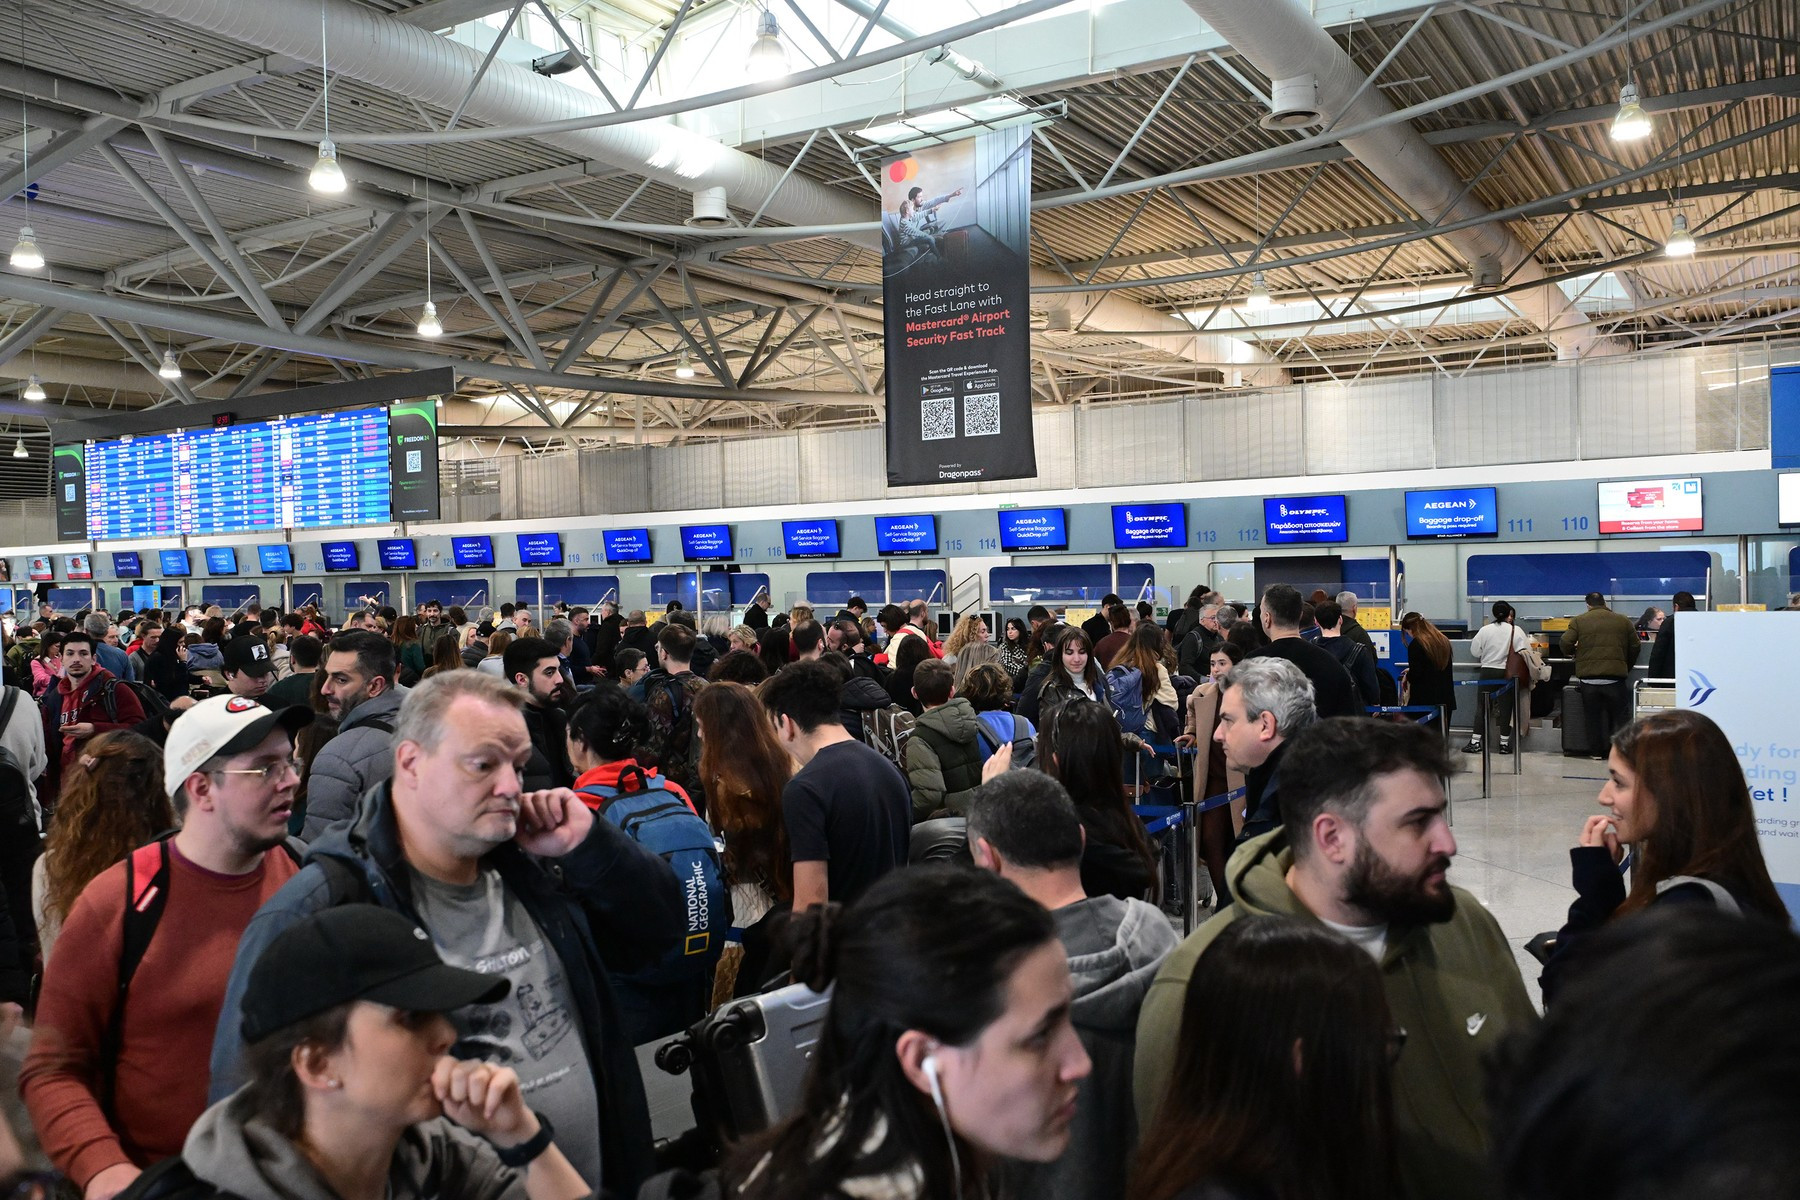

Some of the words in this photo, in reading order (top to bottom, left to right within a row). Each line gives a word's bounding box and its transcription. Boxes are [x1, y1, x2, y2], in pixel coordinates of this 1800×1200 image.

[905, 289, 932, 303] Head
[934, 284, 976, 298] straight
[978, 282, 990, 292] to
[906, 307, 922, 318] the
[924, 303, 948, 315] Fast
[950, 300, 976, 311] Lane
[978, 294, 1002, 307] with
[972, 309, 1010, 323] Airport
[906, 334, 948, 348] Security
[950, 330, 974, 341] Fast
[976, 325, 1005, 338] Track
[939, 469, 982, 479] Dragonpass
[1453, 515, 1484, 523] drop-off
[1562, 516, 1588, 530] 110
[1270, 522, 1303, 530] Παράδοση
[1508, 518, 1533, 532] 111
[1196, 531, 1216, 542] 113
[1238, 529, 1259, 541] 112
[946, 540, 962, 550] 115
[979, 538, 996, 549] 114
[592, 552, 604, 562] 118
[740, 548, 753, 557] 117
[768, 547, 782, 556] 116
[422, 558, 432, 566] 121
[444, 558, 454, 567] 120
[568, 554, 580, 563] 119
[692, 860, 708, 930] GEOGRAPHIC
[685, 876, 698, 932] NATIONAL
